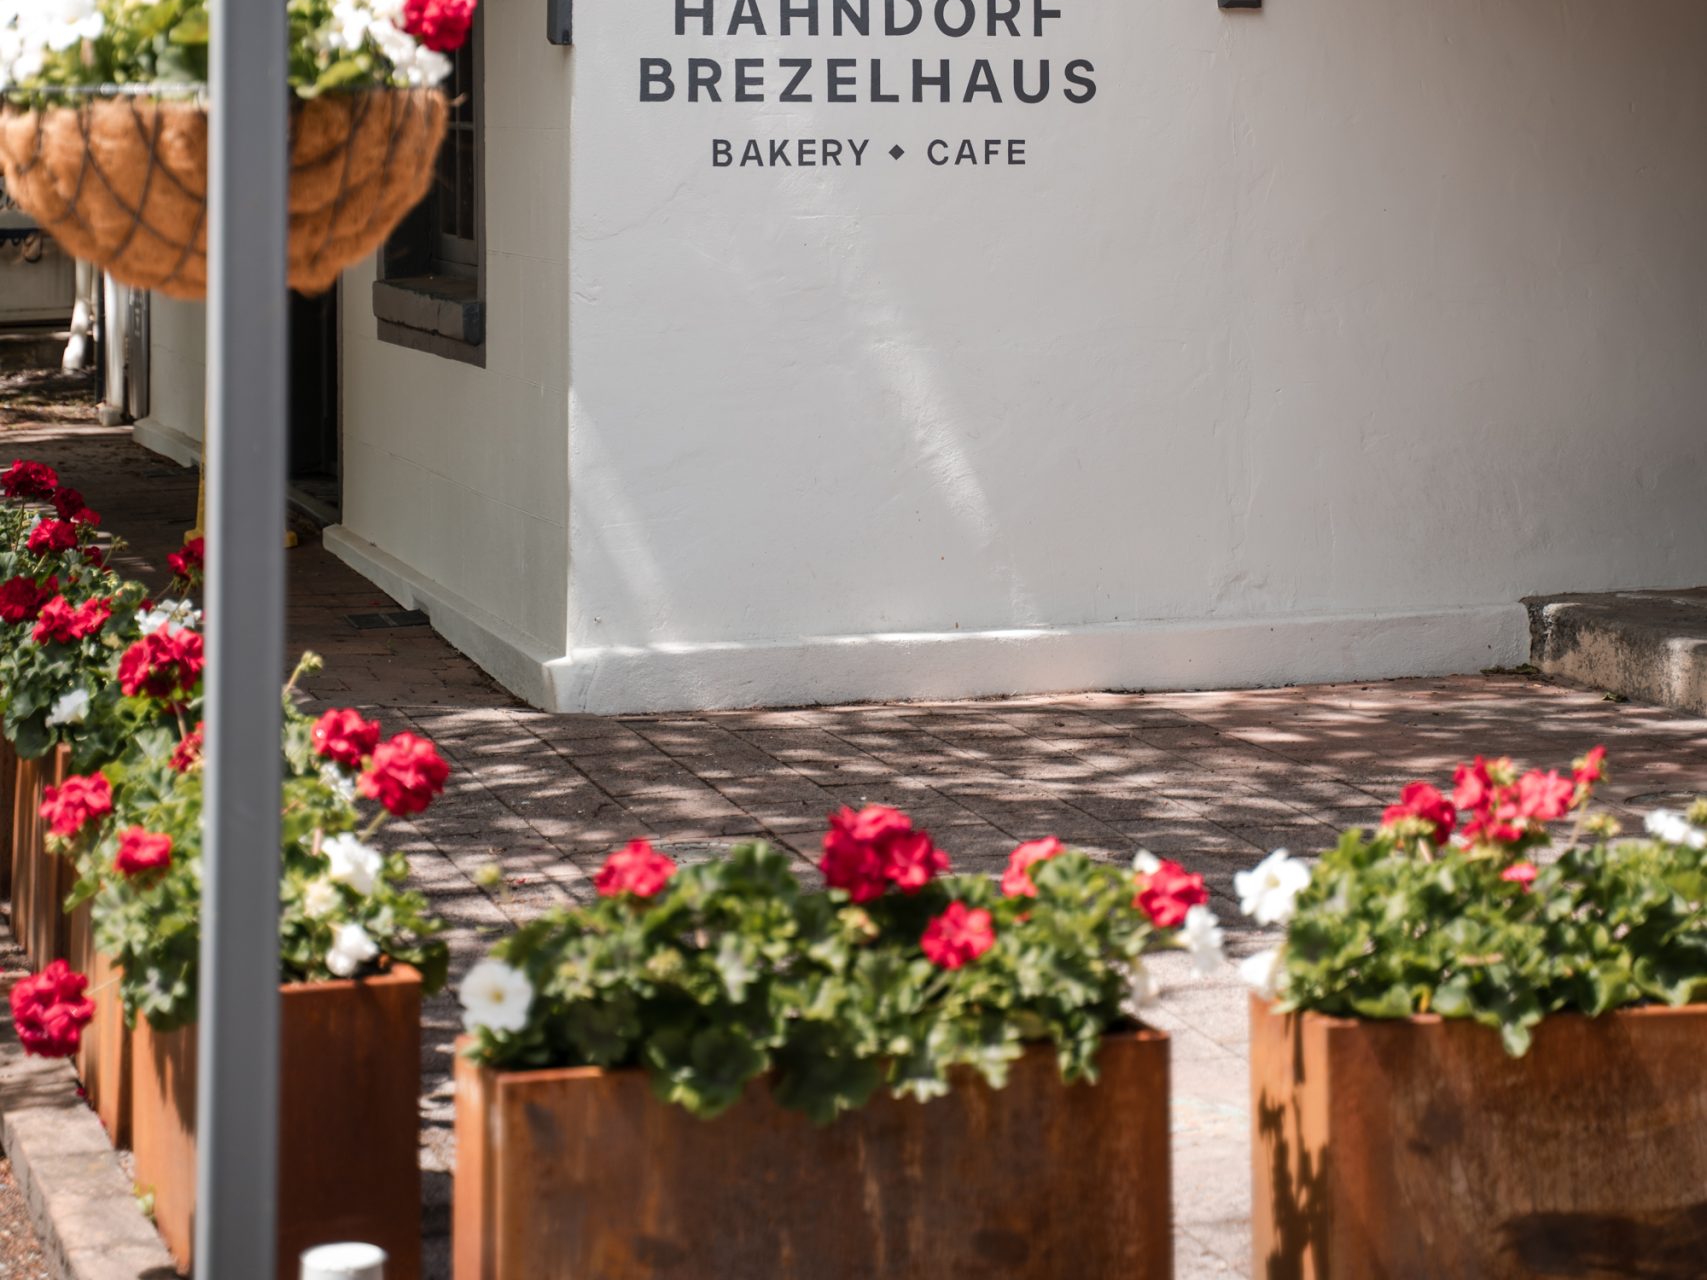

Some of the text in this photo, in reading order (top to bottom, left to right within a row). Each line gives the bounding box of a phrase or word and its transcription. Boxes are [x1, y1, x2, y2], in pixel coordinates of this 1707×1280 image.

[639, 57, 1097, 104] BREZELHAUS
[712, 138, 1026, 167] BAKERY CAFE
